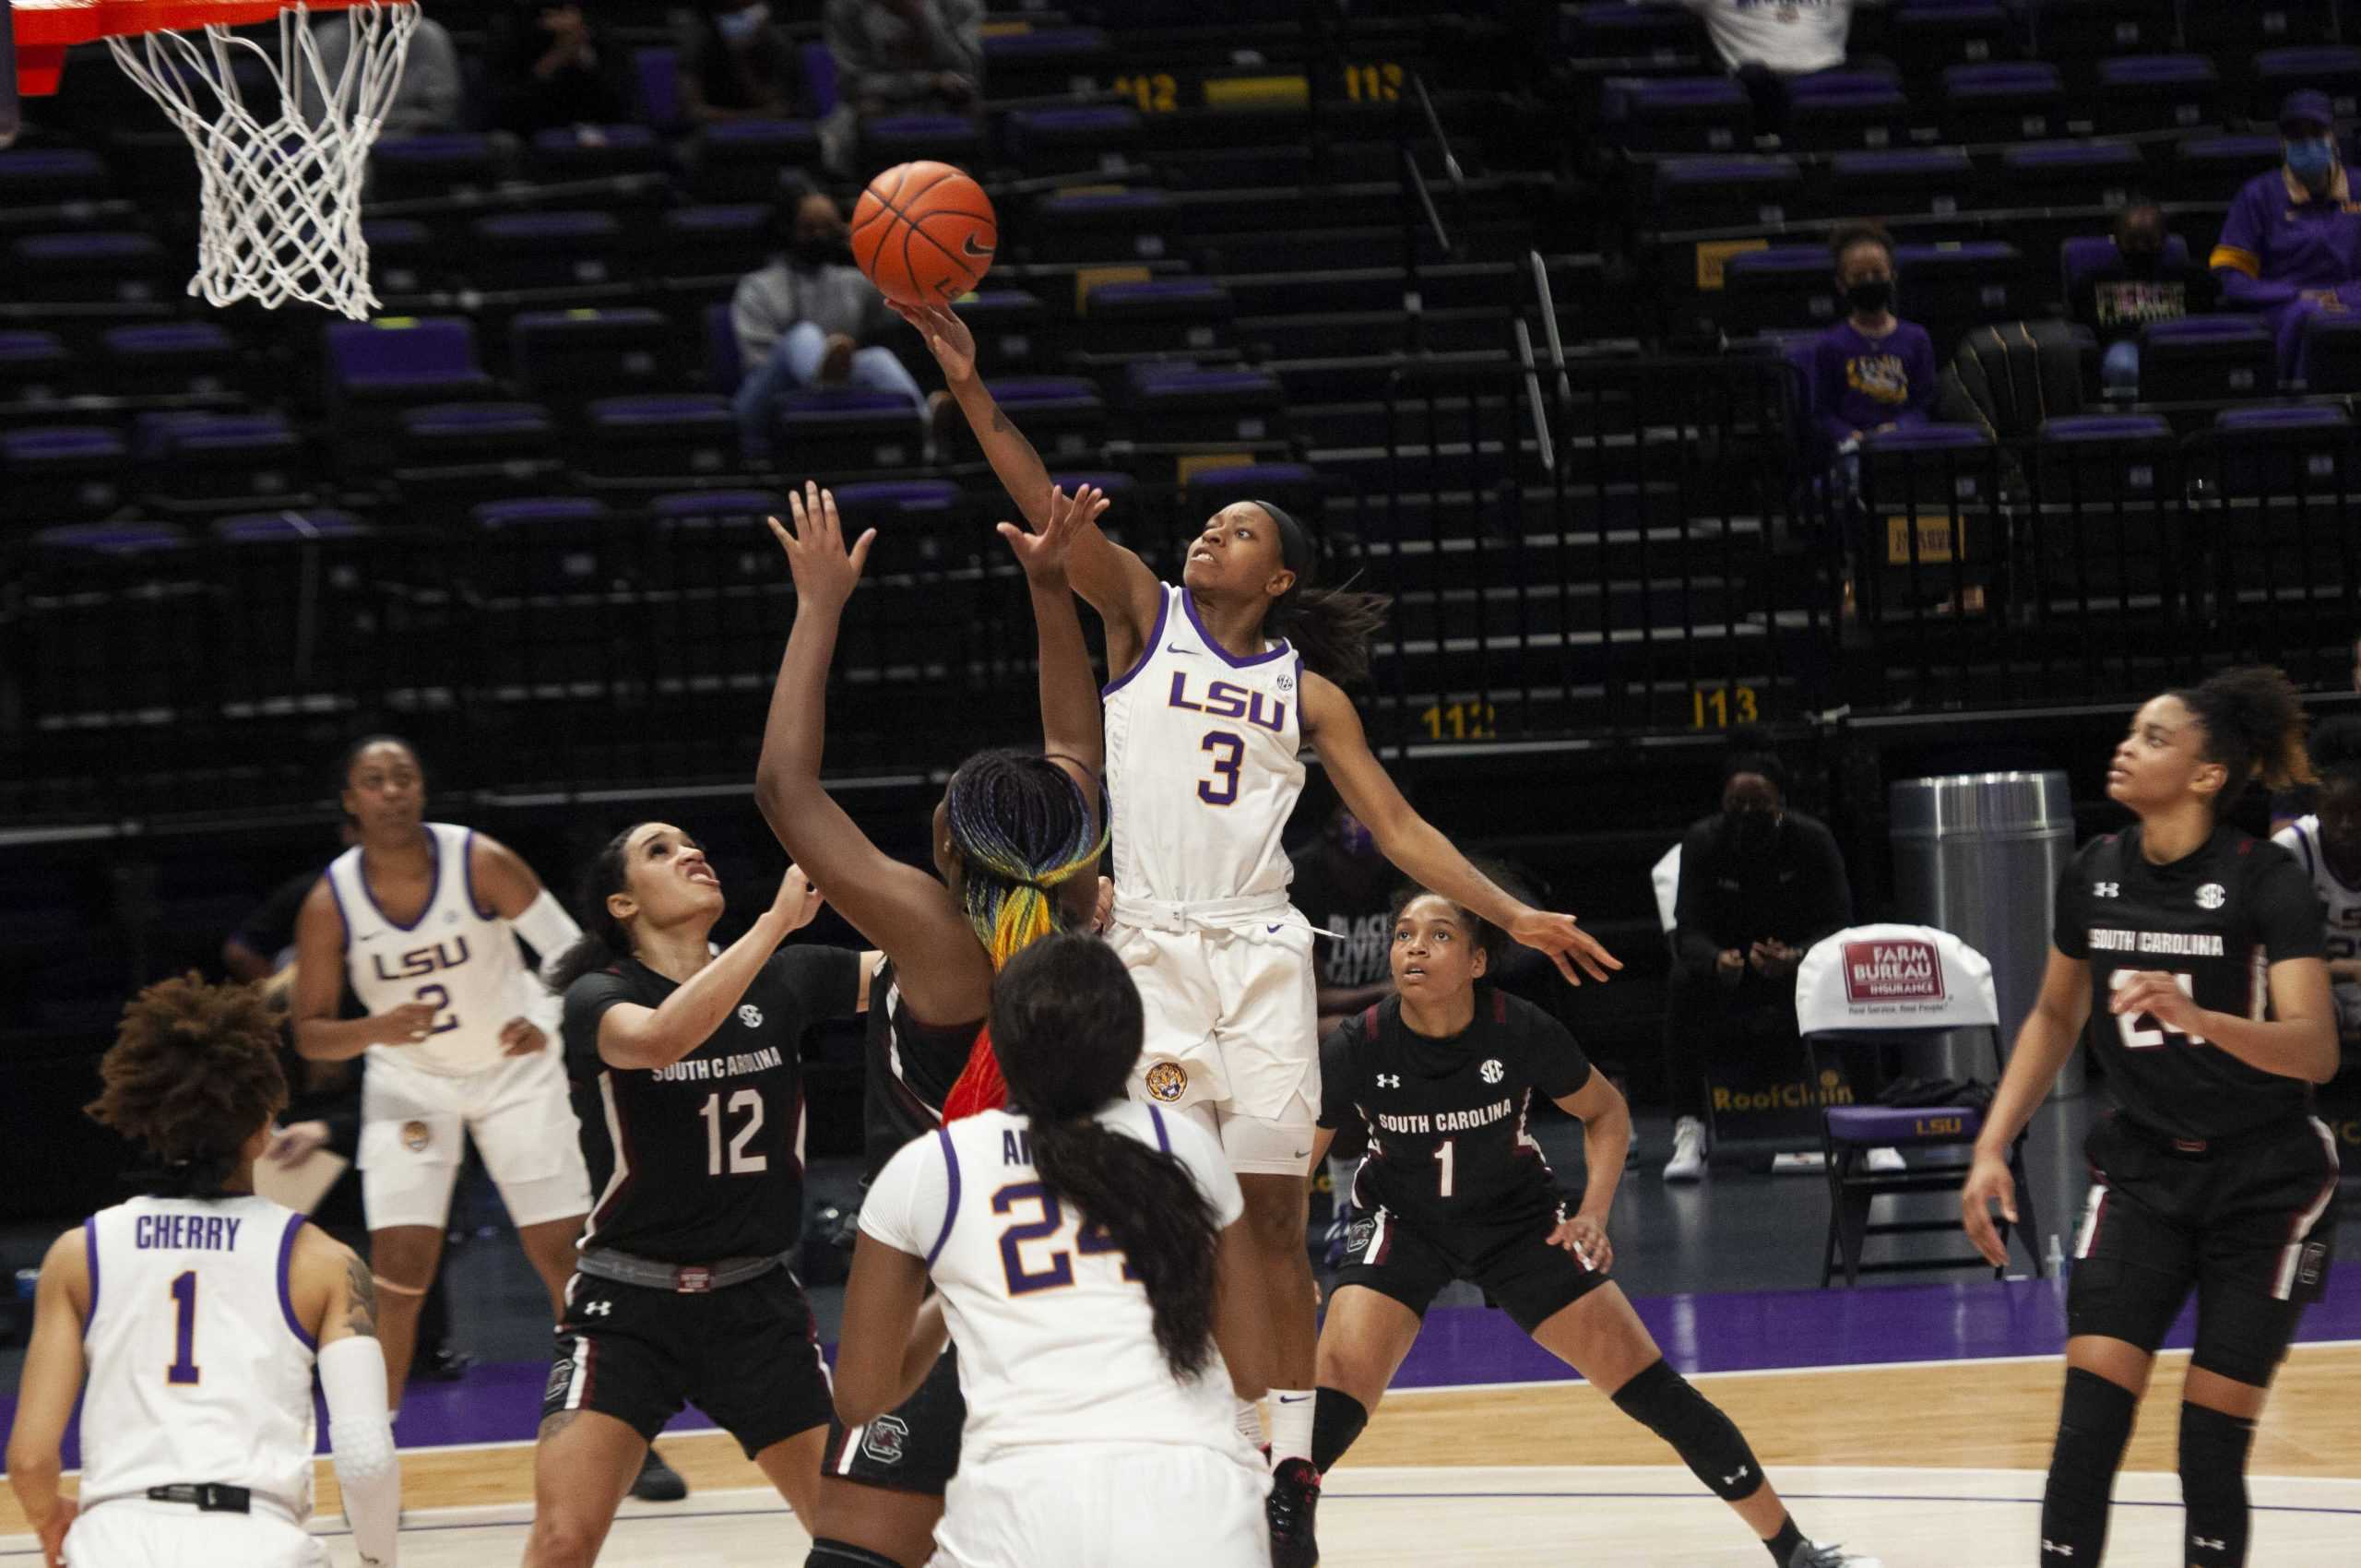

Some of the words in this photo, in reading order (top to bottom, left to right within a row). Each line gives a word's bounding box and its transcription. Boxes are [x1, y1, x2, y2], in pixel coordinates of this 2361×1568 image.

[1169, 671, 1286, 733] LSU
[1693, 687, 1757, 731] 113
[1197, 730, 1244, 806] 3
[373, 935, 469, 980] LSU
[1873, 944, 1929, 963] FARM
[2087, 928, 2137, 951] SOUTH
[2138, 931, 2225, 956] CAROLINA
[1854, 961, 1933, 980] BUREAU
[1870, 980, 1934, 996] INSURANCE
[415, 983, 459, 1035] 2
[652, 1059, 710, 1082] SOUTH
[711, 1046, 783, 1079] CAROLINA
[1479, 1059, 1505, 1084] SEC
[699, 1088, 768, 1176] 12
[1378, 1113, 1430, 1134] SOUTH
[1435, 1098, 1513, 1132] CAROLINA
[1916, 1116, 1962, 1137] LSU
[1434, 1140, 1453, 1198] 1
[136, 1214, 242, 1252] CHERRY
[166, 1270, 200, 1384] 1
